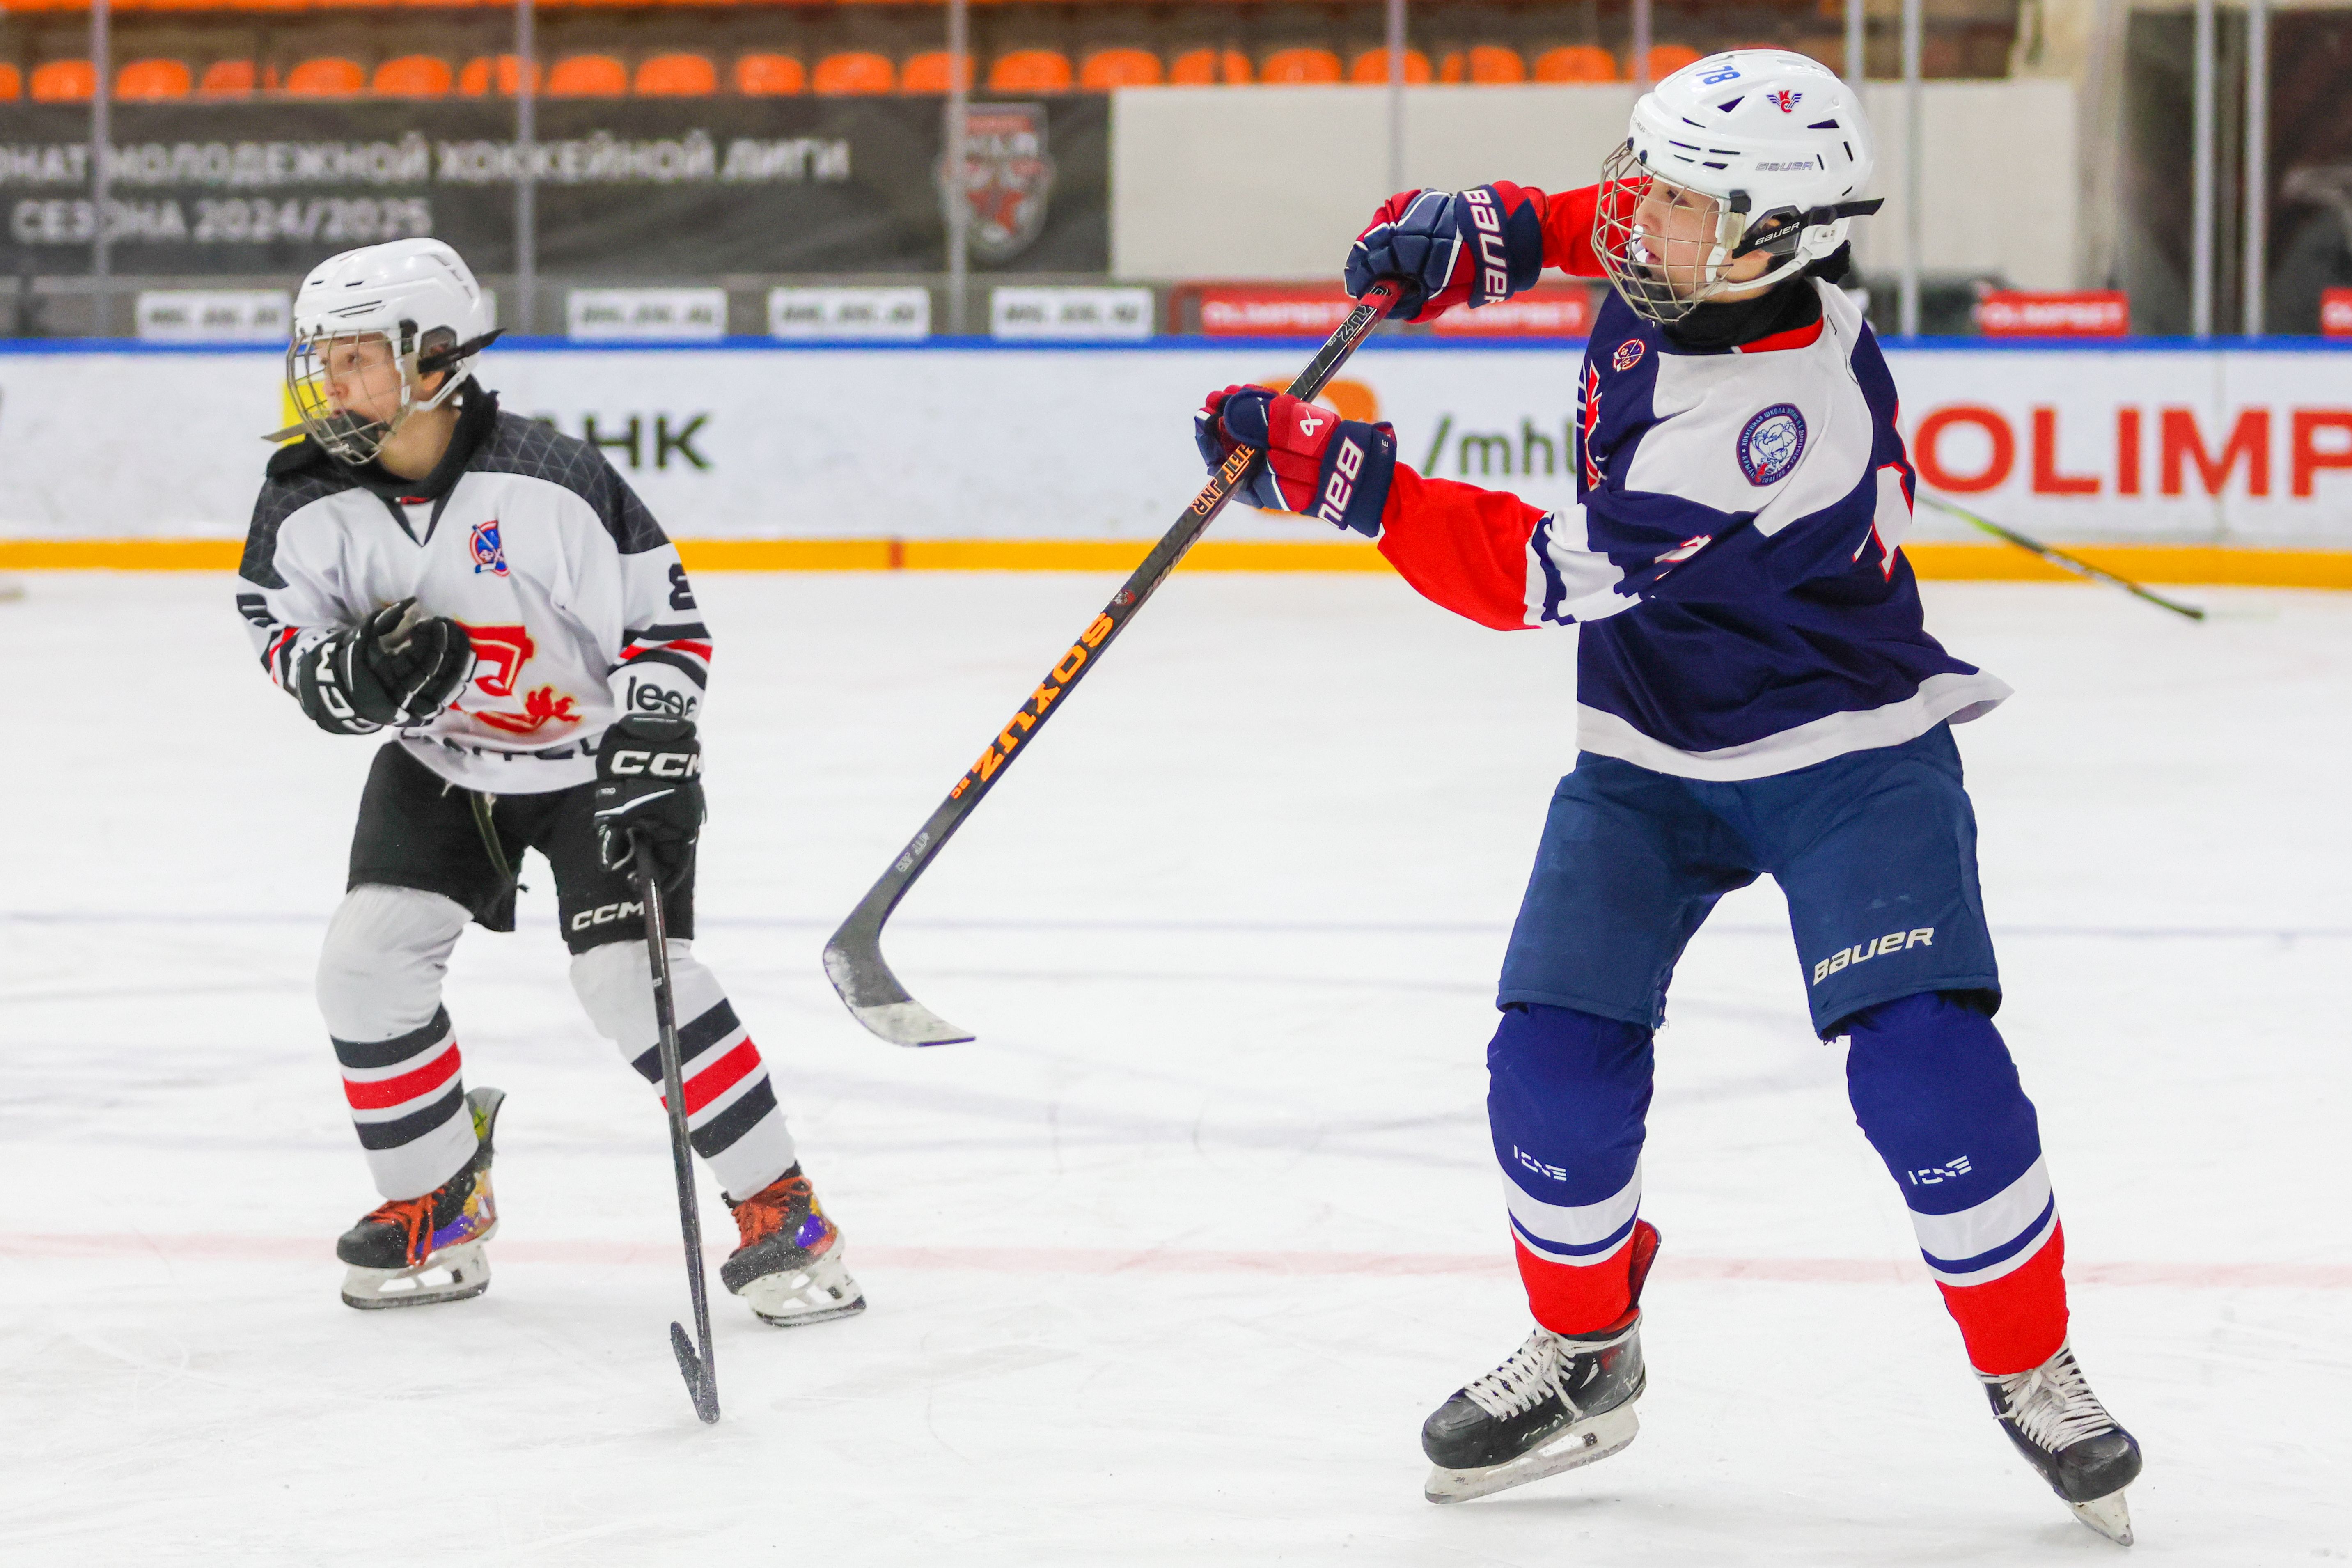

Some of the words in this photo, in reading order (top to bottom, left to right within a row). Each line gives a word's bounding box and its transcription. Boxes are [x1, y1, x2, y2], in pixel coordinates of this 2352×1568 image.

[1696, 65, 1741, 85] 78
[0, 142, 88, 181] НАТ
[440, 130, 716, 183] ХОККЕЙНОЙ
[722, 137, 851, 183] ЛИГИ
[10, 199, 188, 243] СЕЗОНА
[193, 195, 433, 244] 2024/2025
[1754, 221, 1800, 246] BAUER
[1913, 404, 2352, 496] OLIMP
[970, 612, 1114, 782] SOYUZ
[572, 901, 646, 931] CCM
[1813, 927, 1935, 986] BAUER
